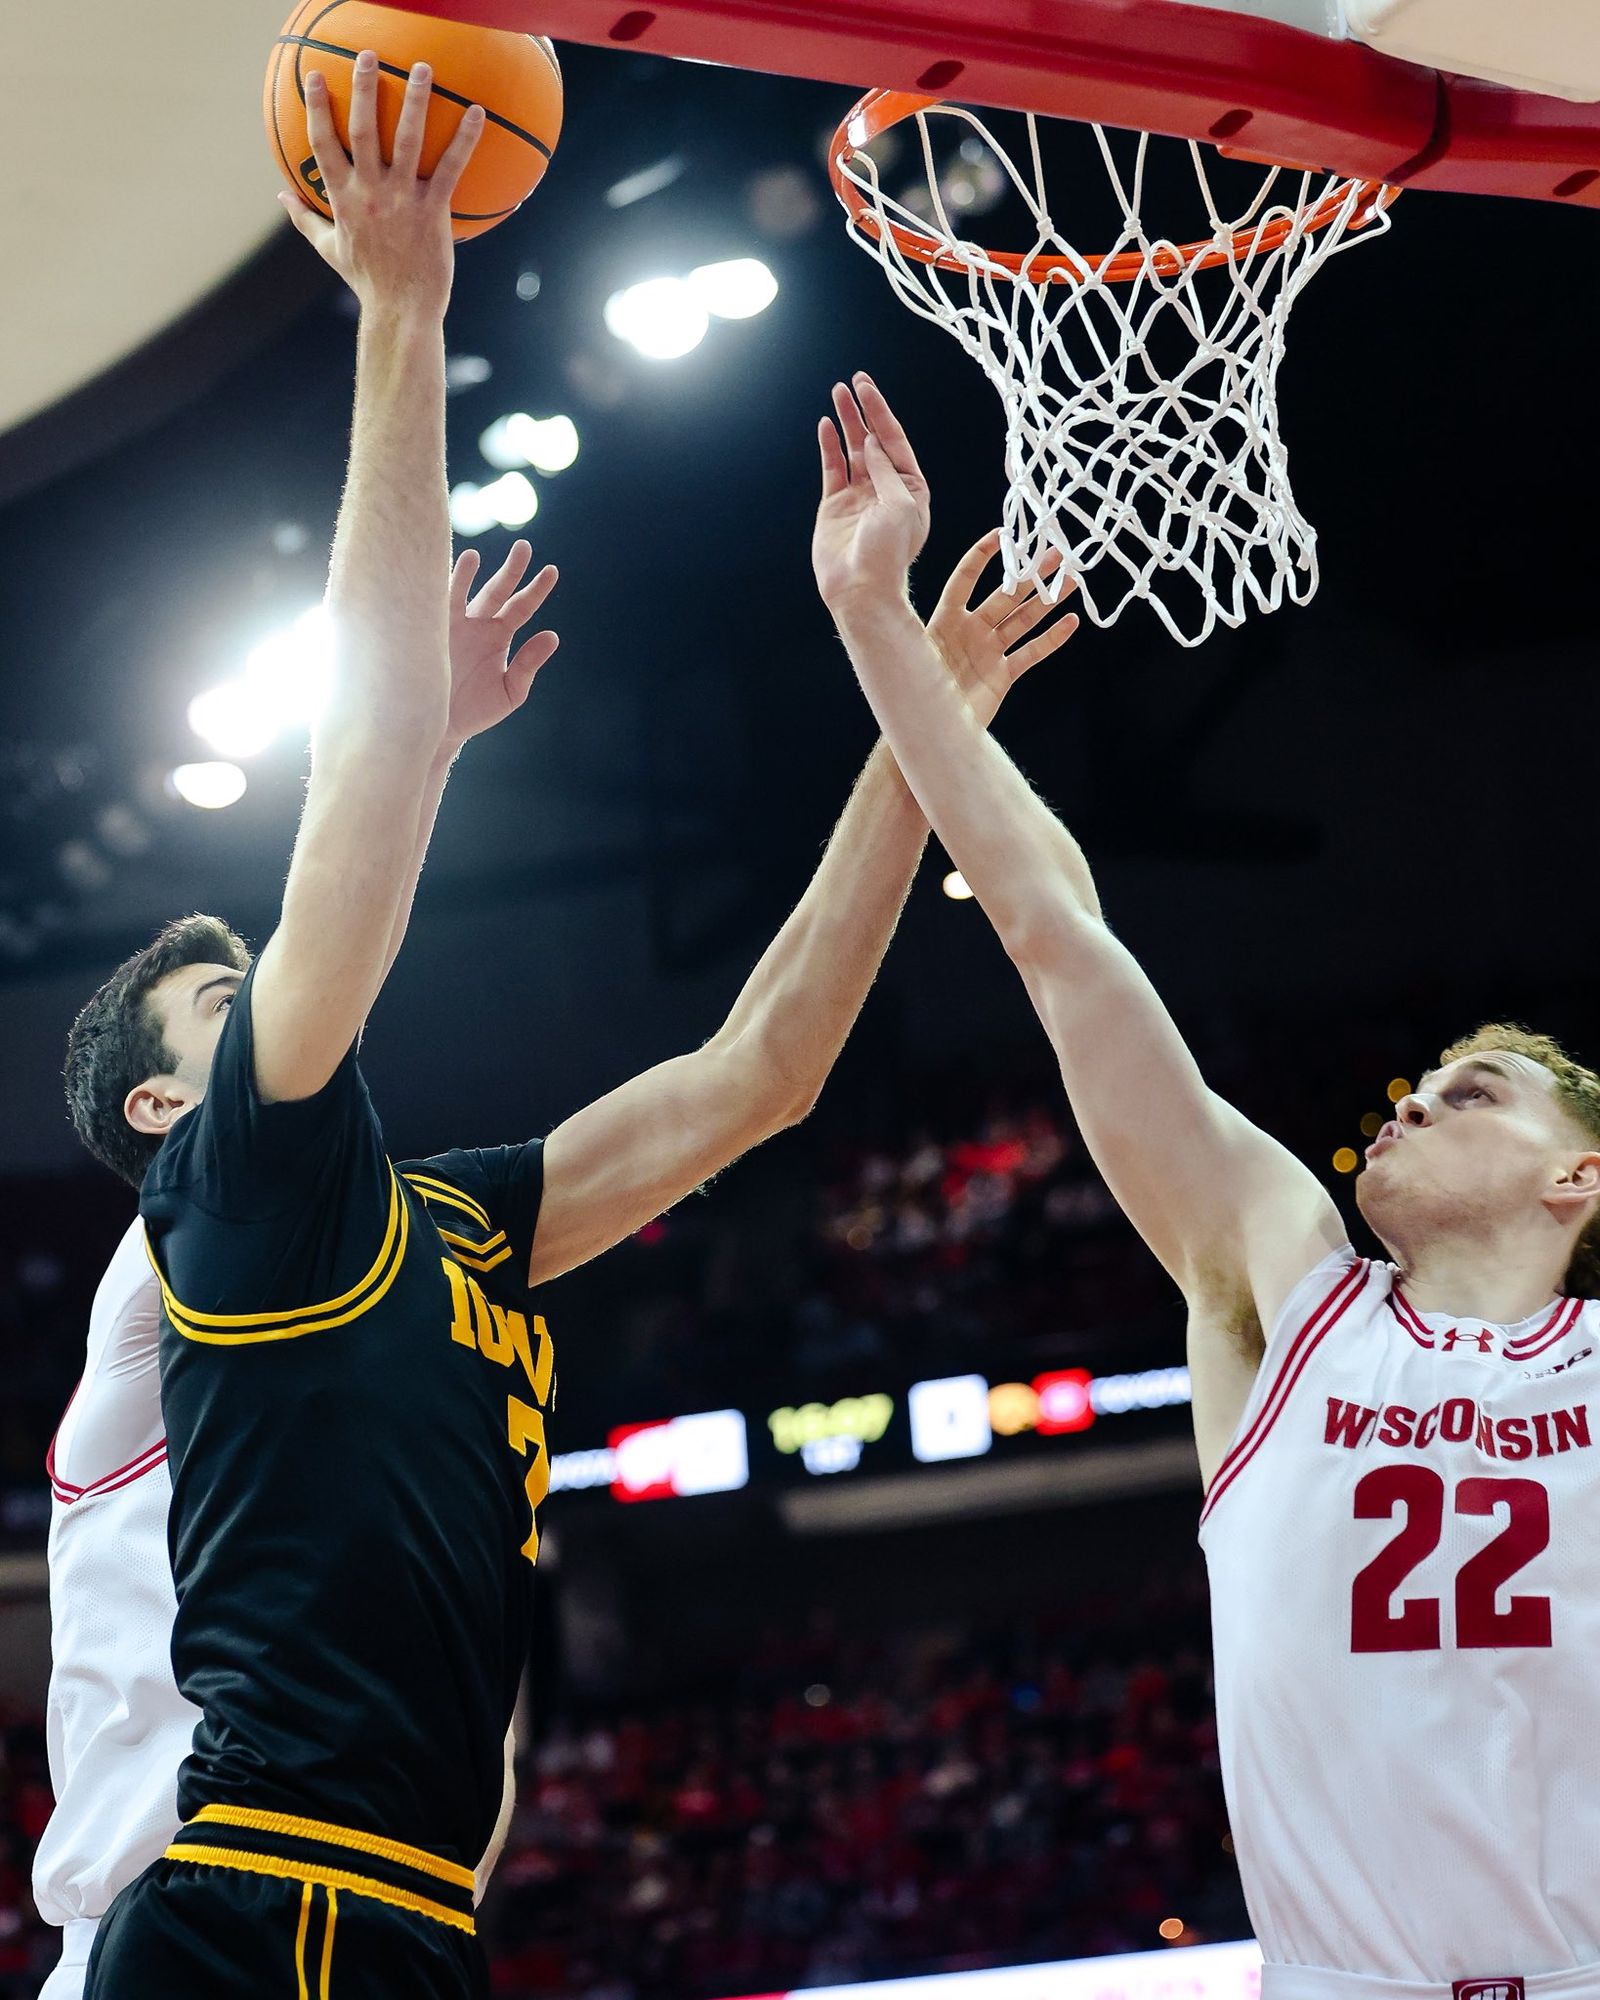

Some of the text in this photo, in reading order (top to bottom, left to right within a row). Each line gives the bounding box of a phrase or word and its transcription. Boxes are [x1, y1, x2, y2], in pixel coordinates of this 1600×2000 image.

[507, 1394, 550, 1567] 7
[1324, 1396, 1592, 1461] WSCONSIN
[1351, 1464, 1552, 1653] 22
